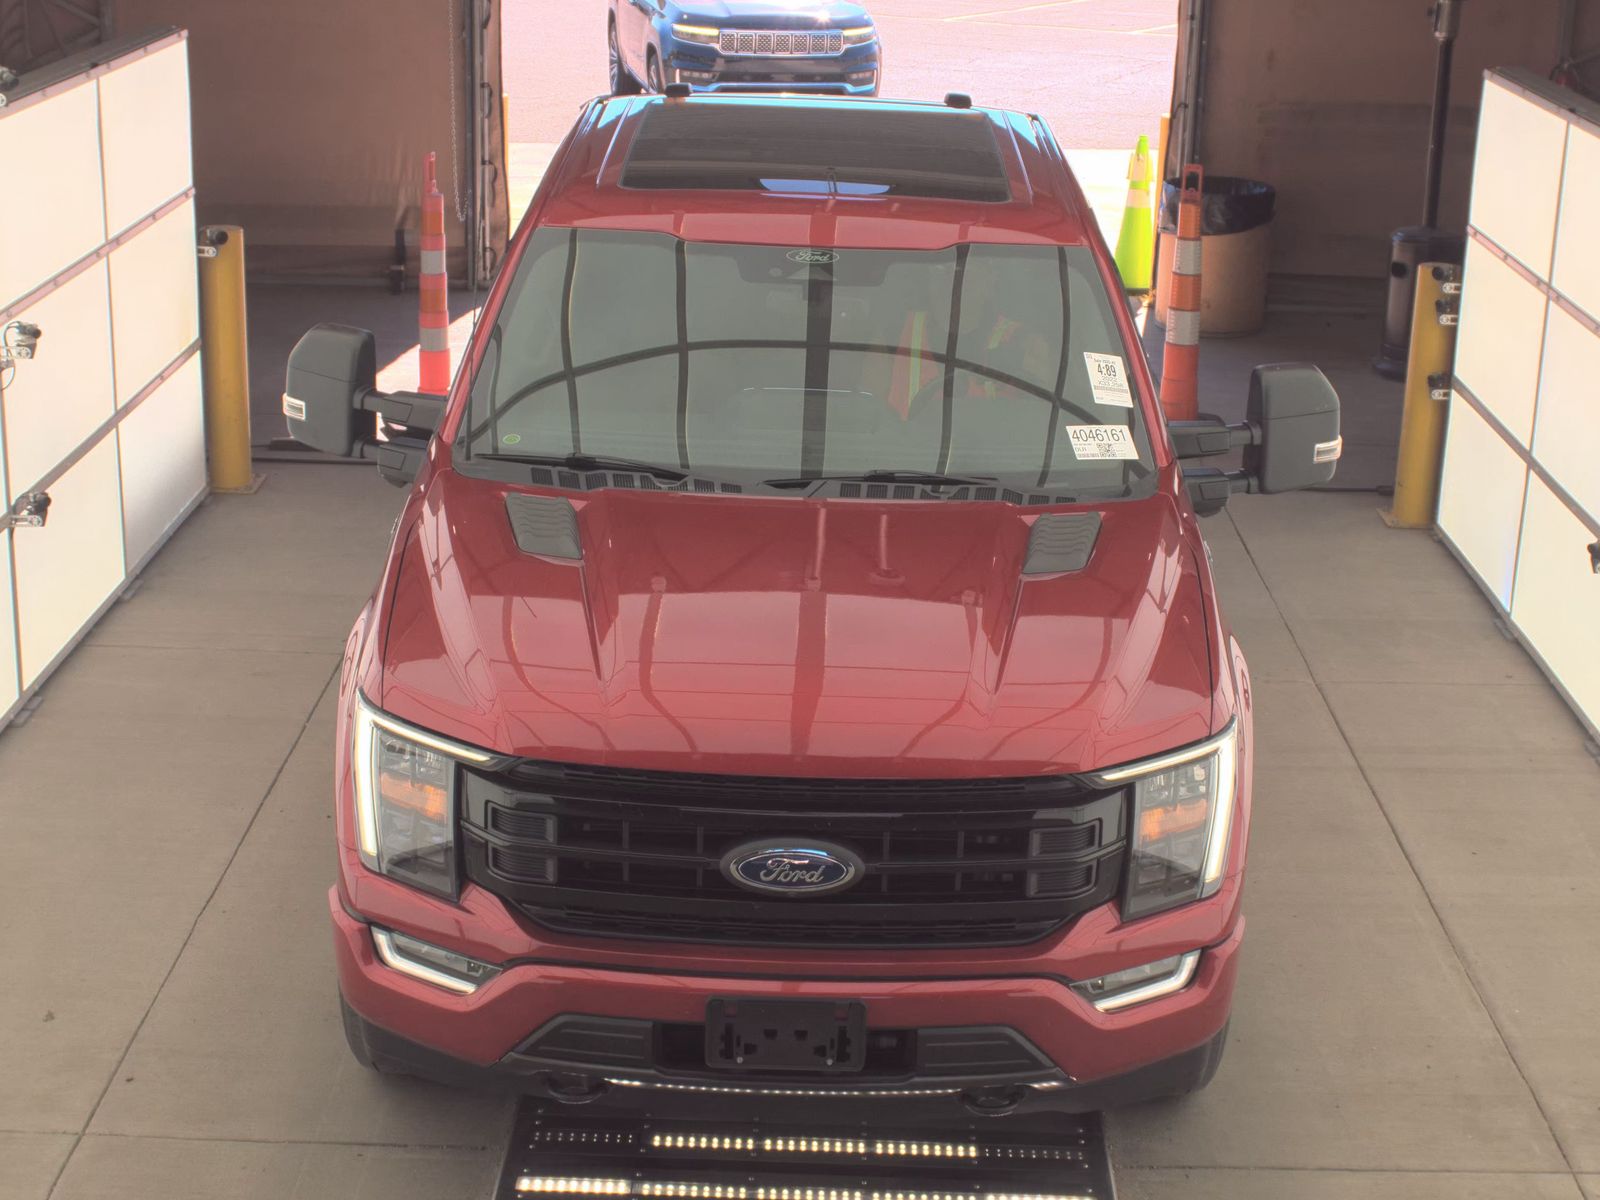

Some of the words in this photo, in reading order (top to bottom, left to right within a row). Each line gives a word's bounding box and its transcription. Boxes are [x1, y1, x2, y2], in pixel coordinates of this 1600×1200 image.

[796, 249, 831, 261] Ford
[1072, 428, 1127, 442] 4046161
[760, 858, 825, 882] Ford
